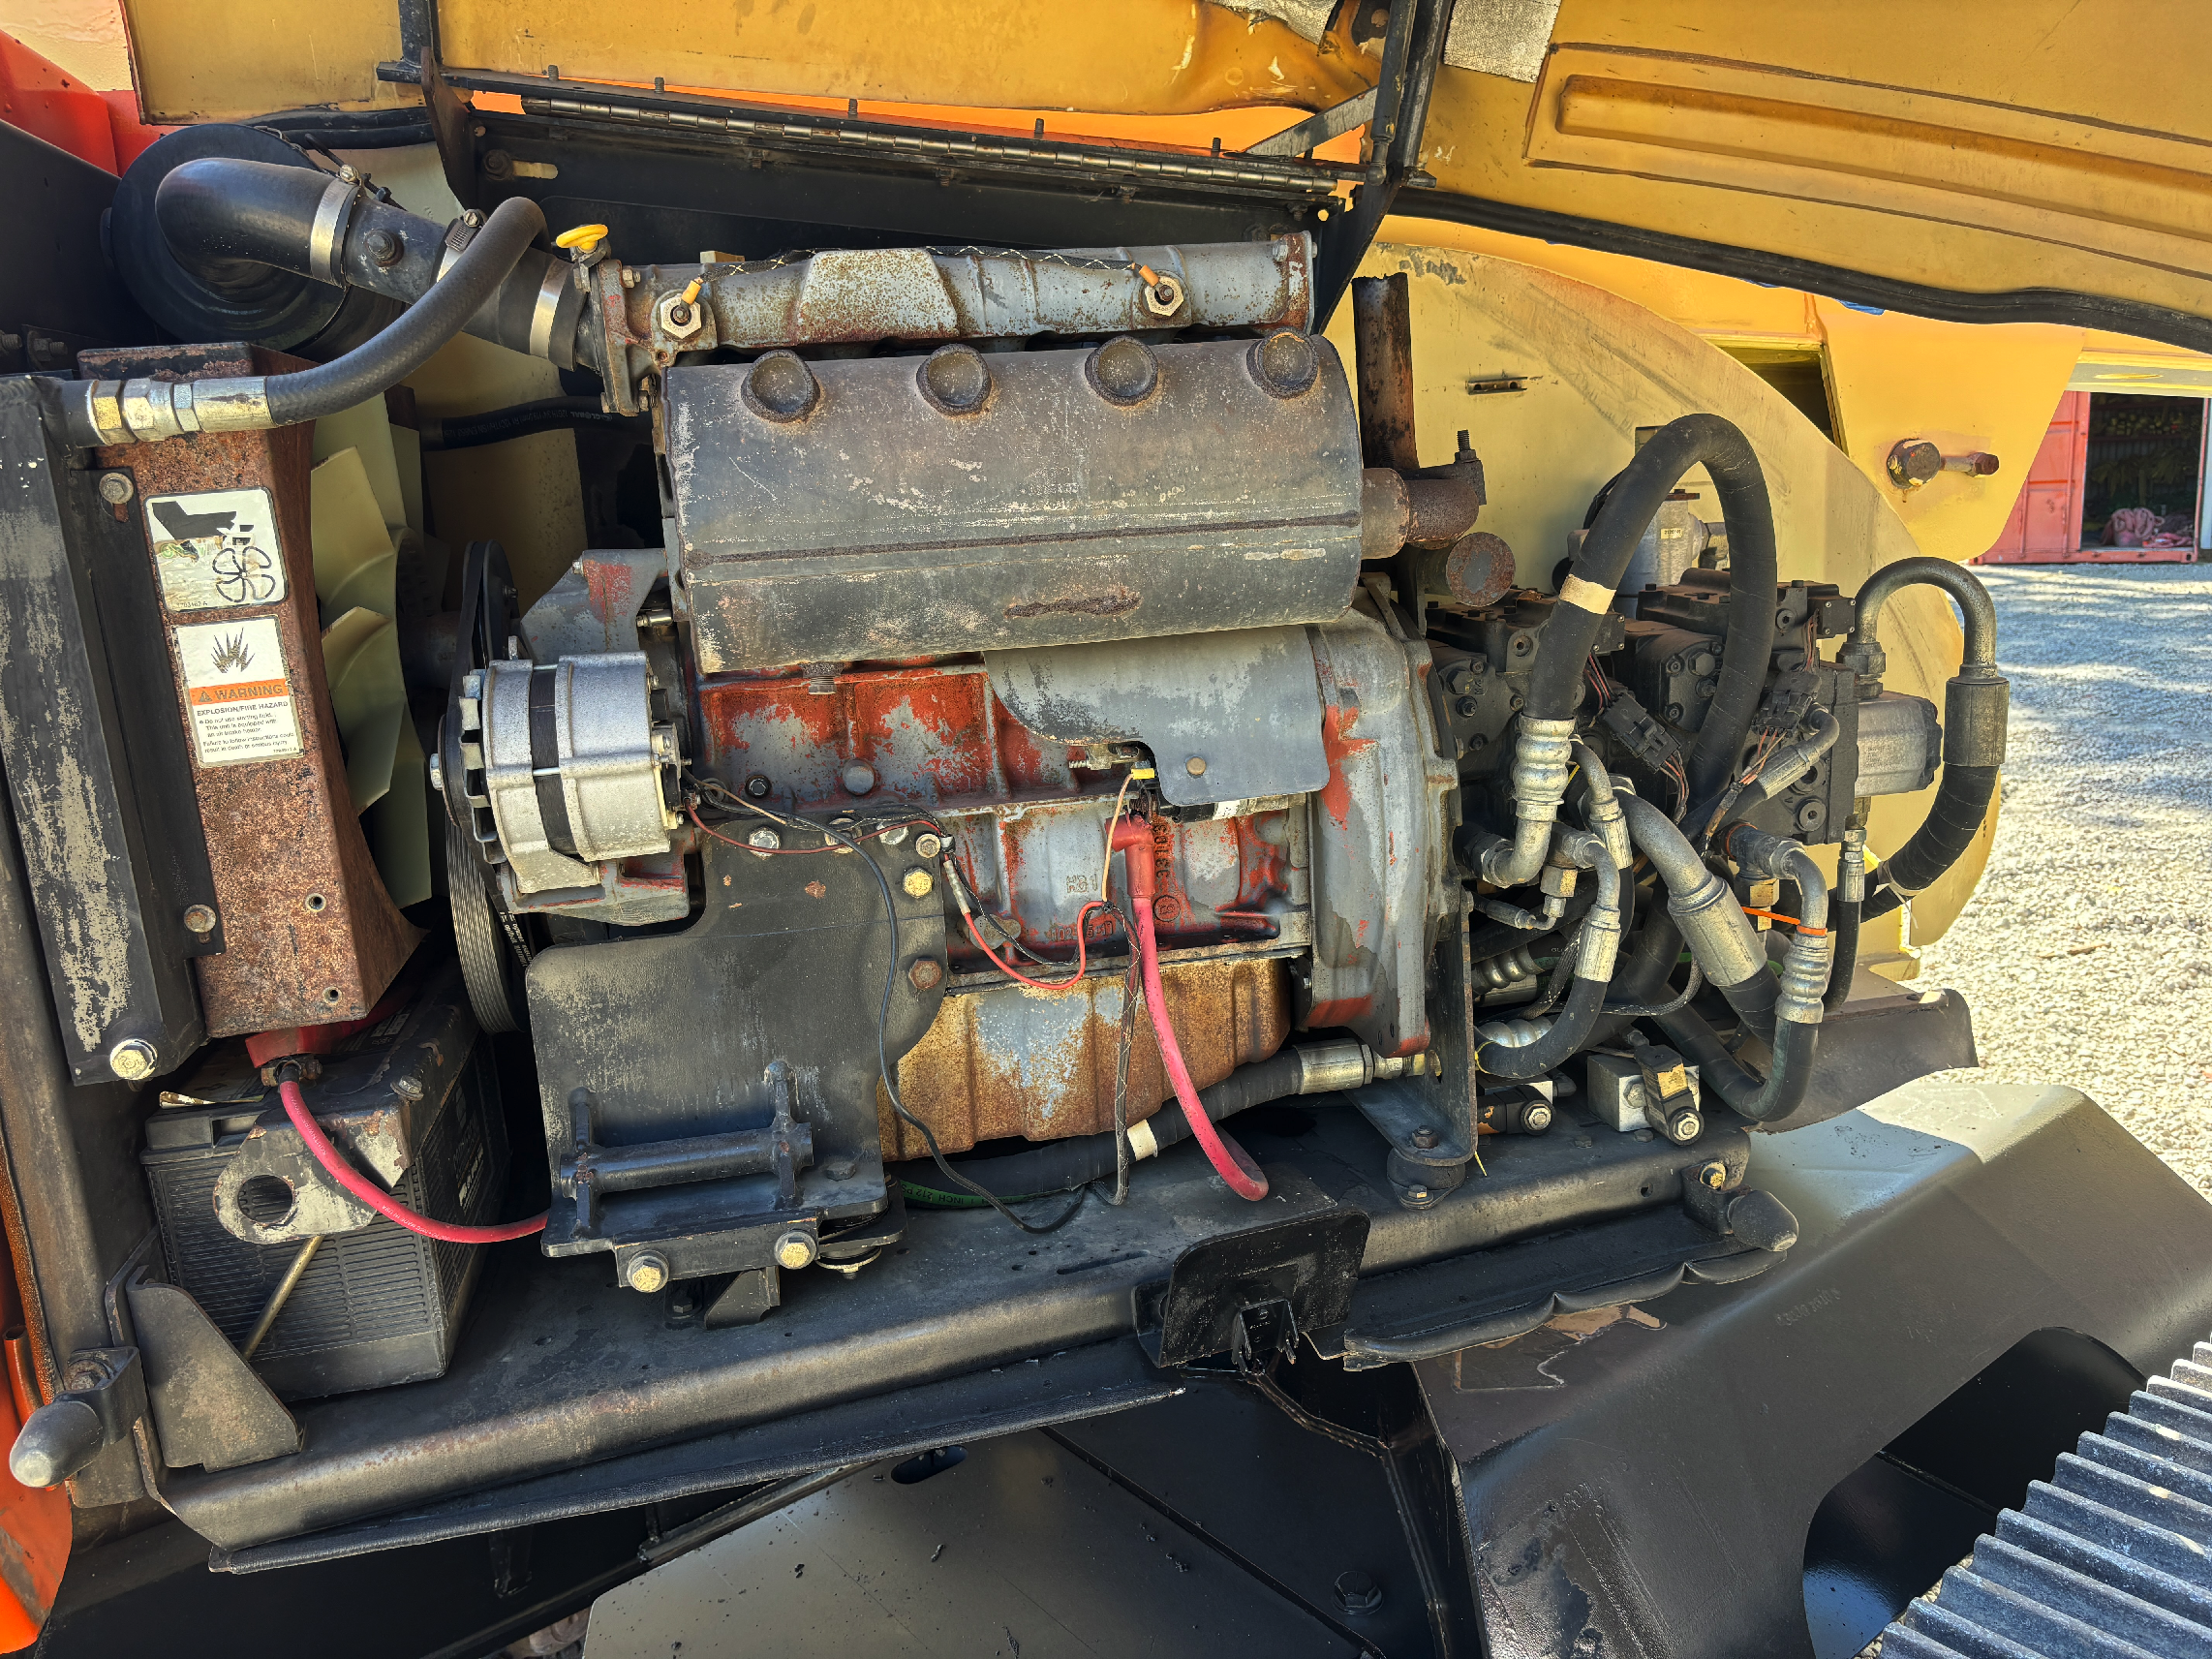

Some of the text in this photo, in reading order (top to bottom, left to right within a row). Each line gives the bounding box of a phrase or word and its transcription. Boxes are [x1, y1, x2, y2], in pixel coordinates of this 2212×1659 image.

[214, 684, 283, 700] WARNING
[258, 700, 289, 711] HAZARD
[916, 1188, 934, 1200] 212
[938, 1194, 964, 1204] INCH
